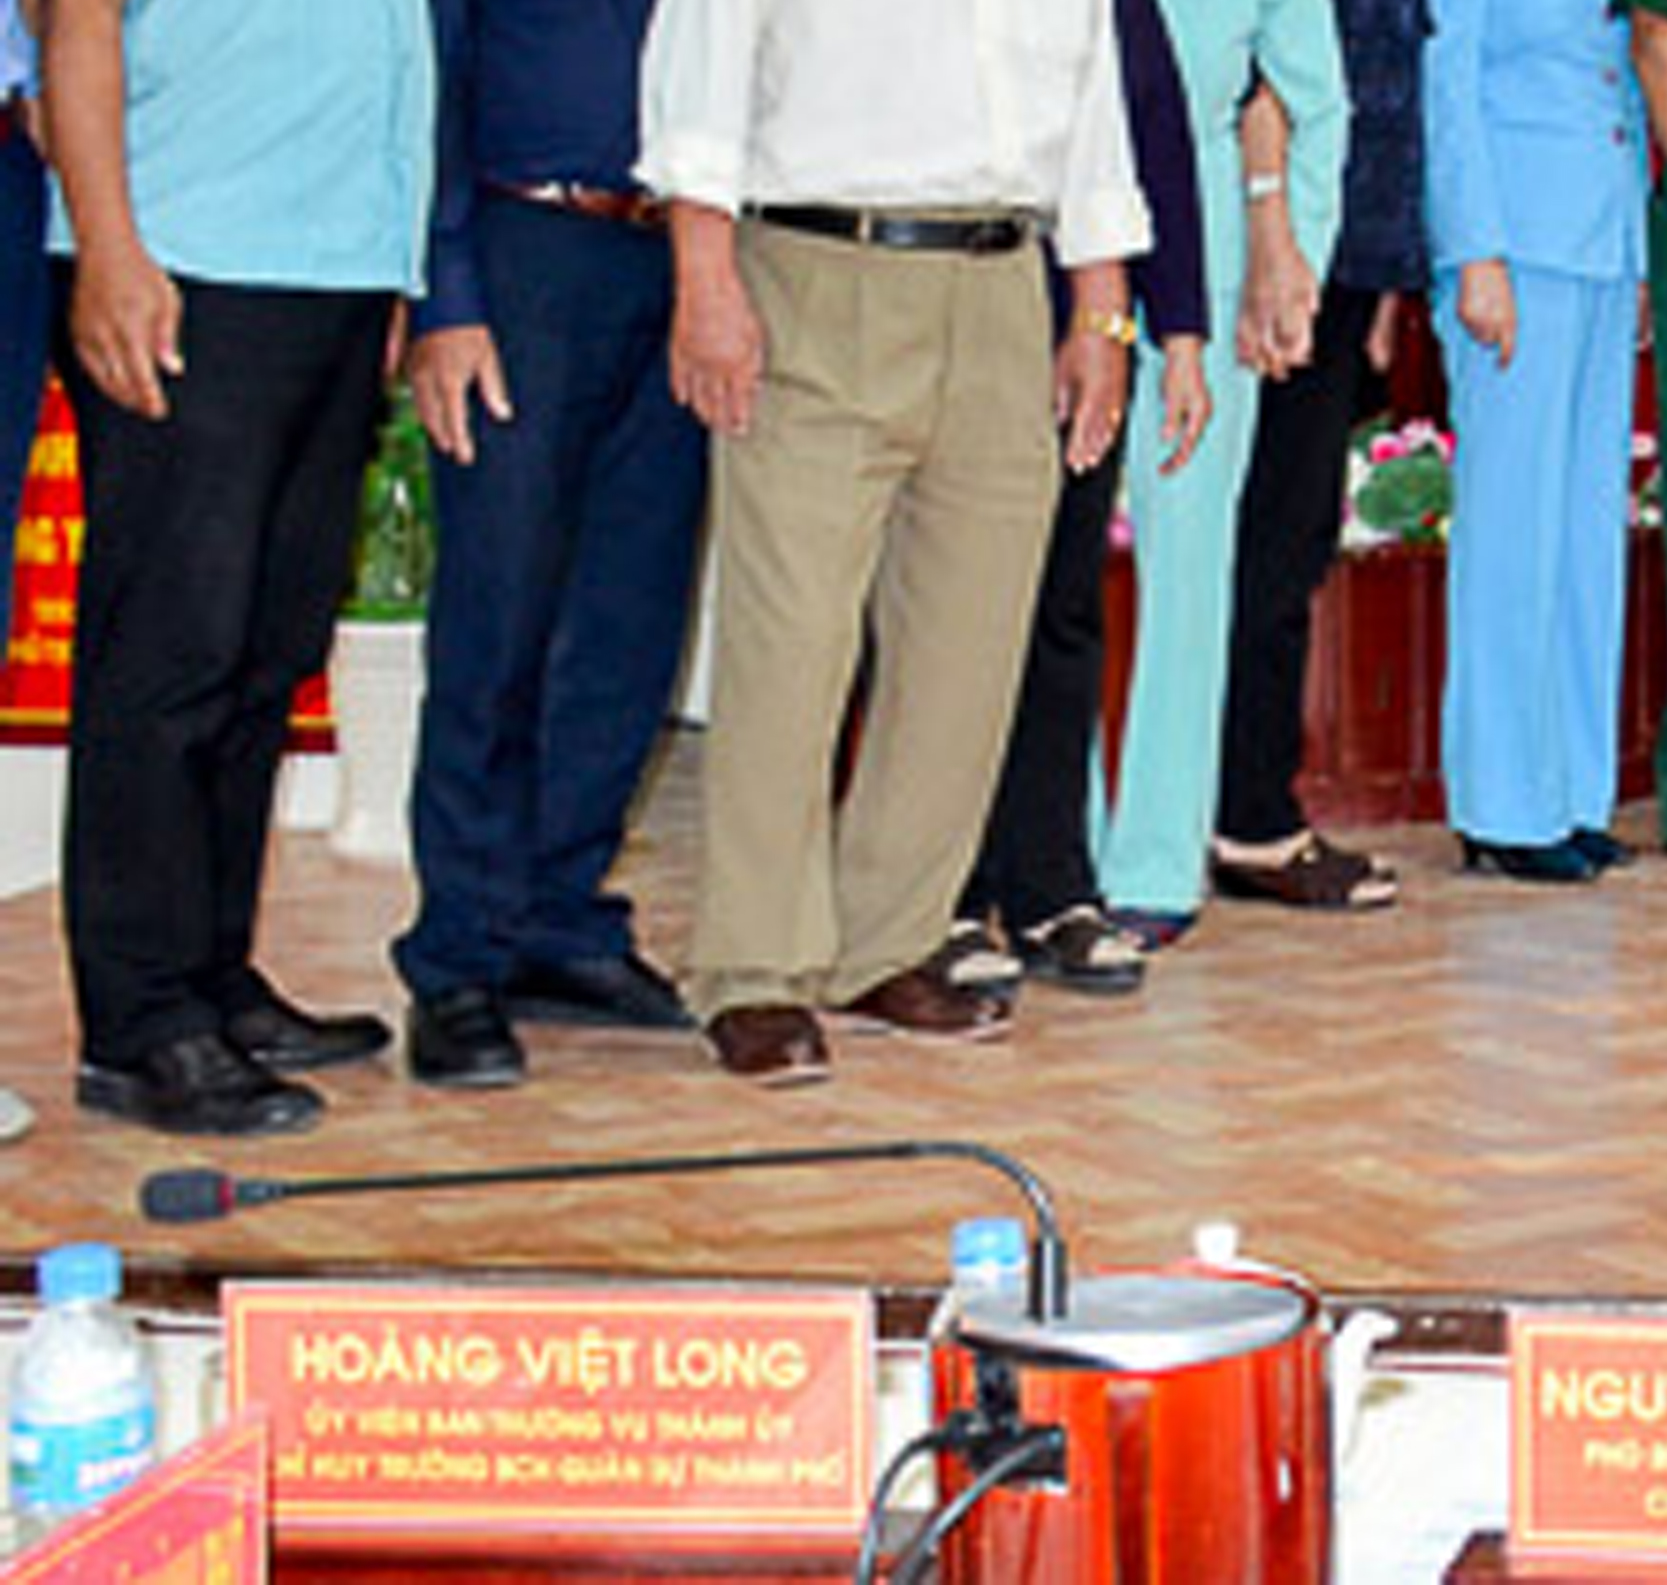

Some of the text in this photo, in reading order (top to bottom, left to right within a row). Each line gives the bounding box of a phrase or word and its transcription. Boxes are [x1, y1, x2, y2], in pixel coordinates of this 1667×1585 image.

[292, 1325, 808, 1397] HOÀNG VIỆT LONG
